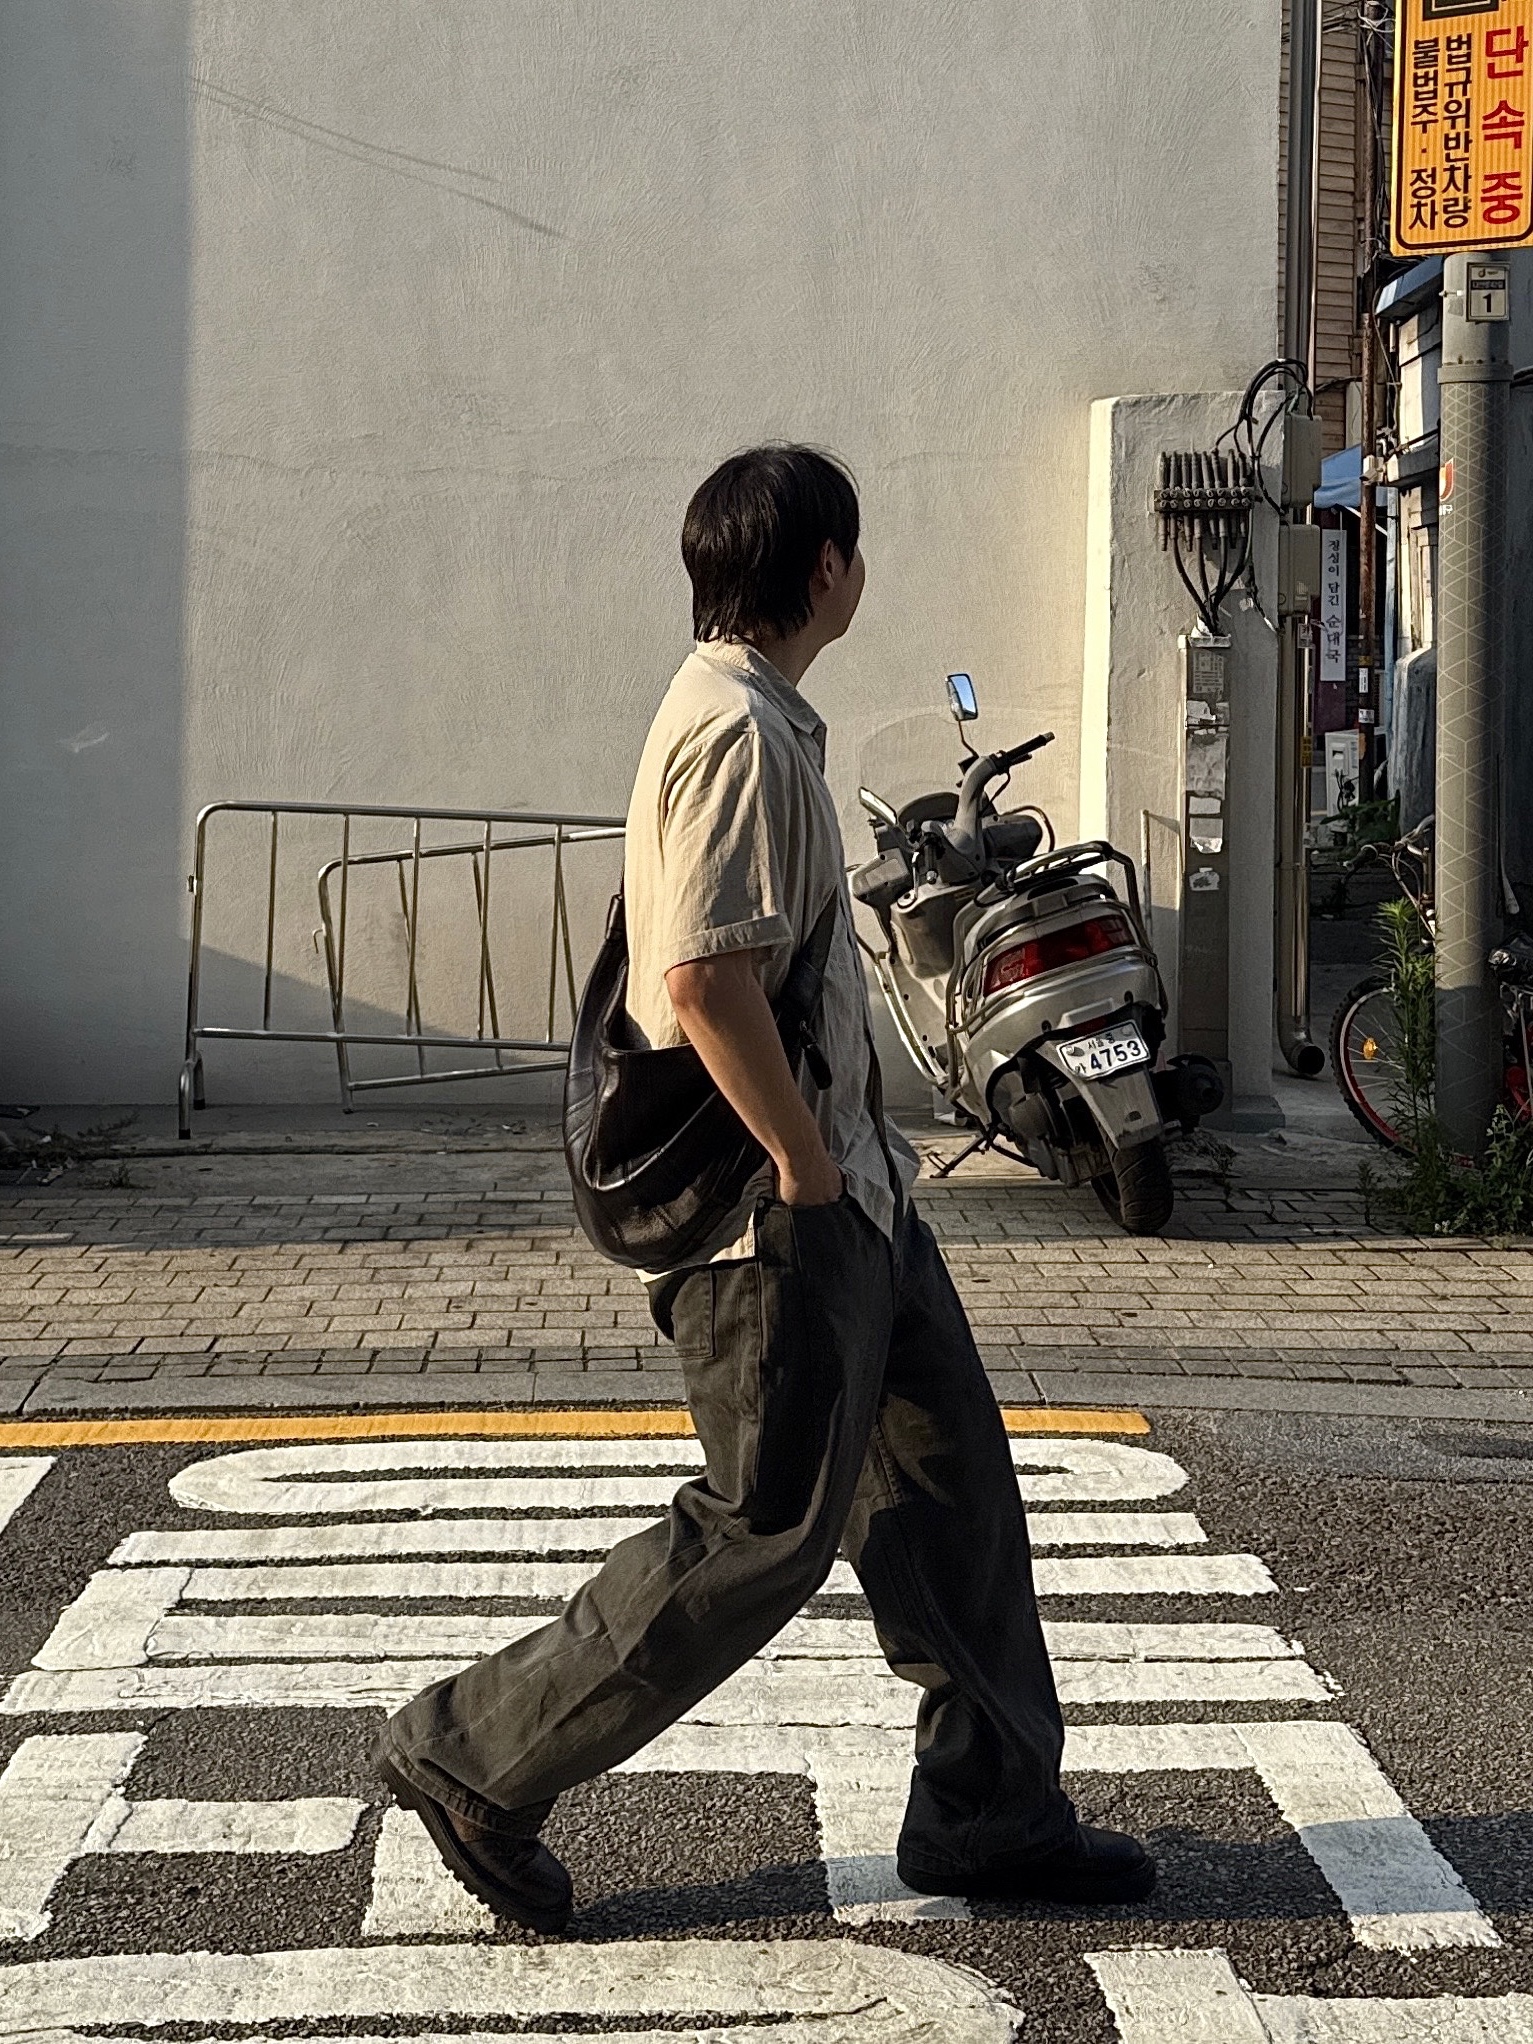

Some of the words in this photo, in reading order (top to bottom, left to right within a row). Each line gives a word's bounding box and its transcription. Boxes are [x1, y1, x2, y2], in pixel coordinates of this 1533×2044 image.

[1441, 32, 1473, 229] 법규위반차량
[1482, 292, 1492, 313] 1
[1088, 1036, 1104, 1049] 서울
[1090, 1040, 1141, 1070] 4753
